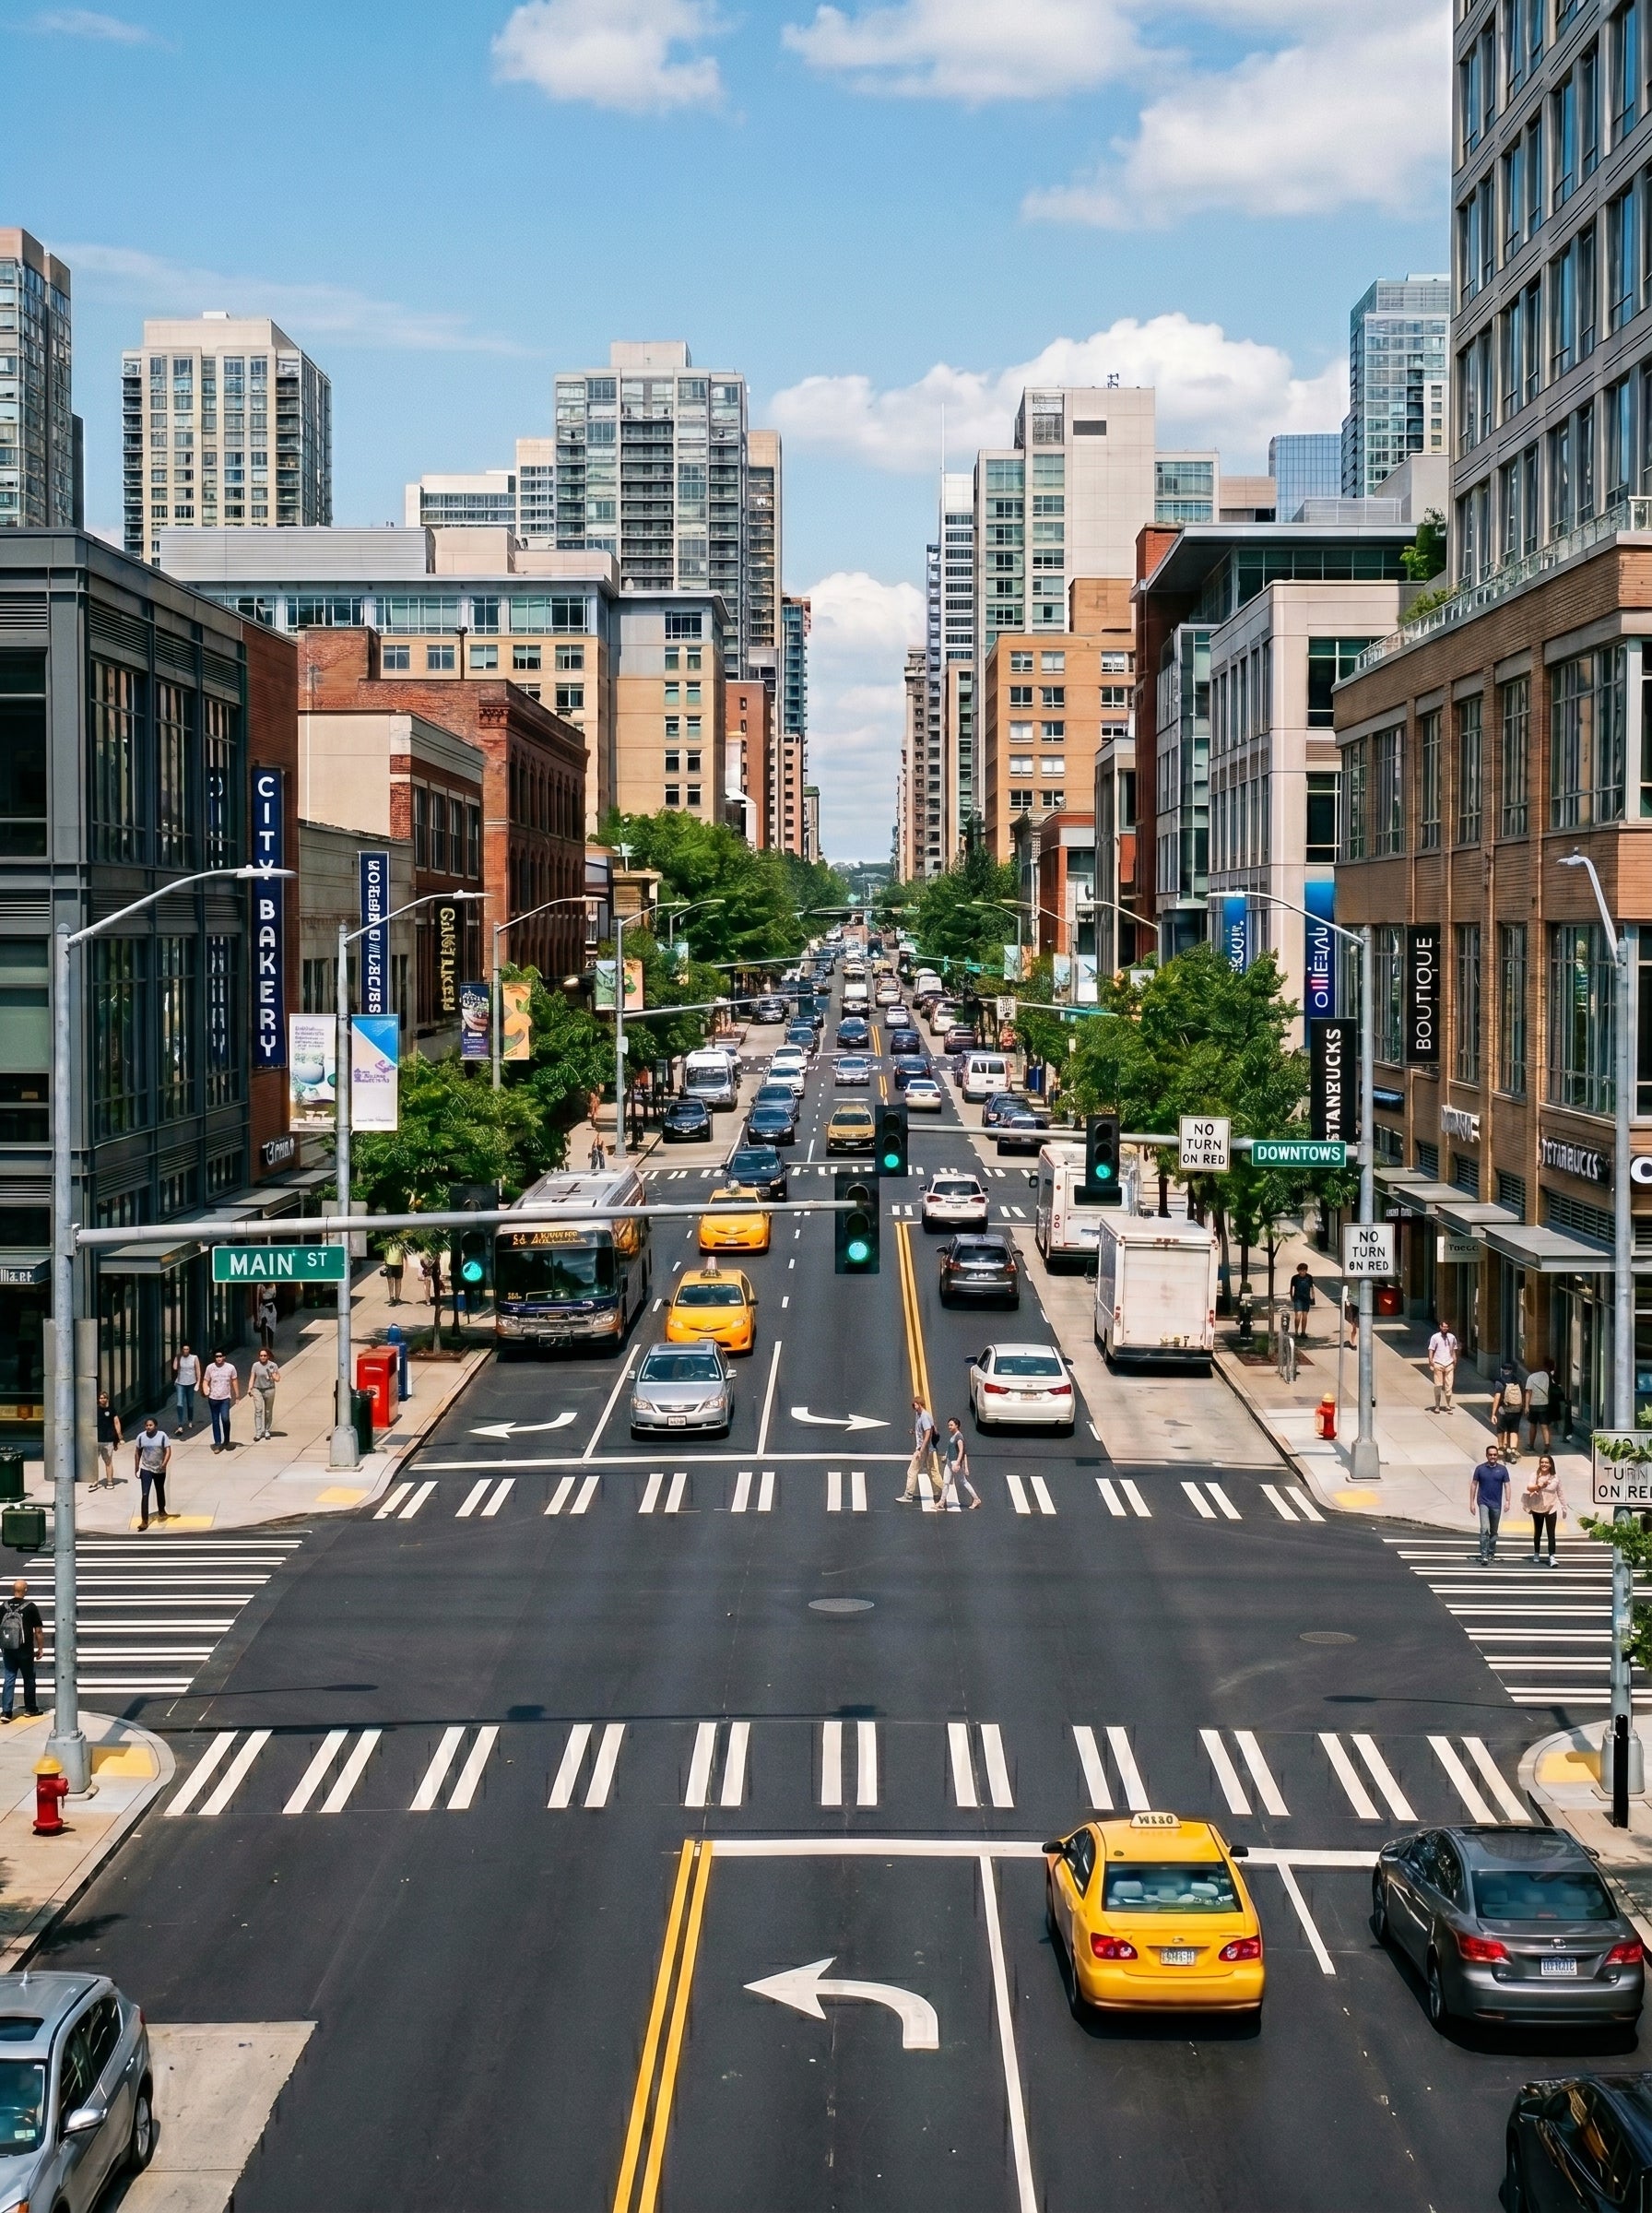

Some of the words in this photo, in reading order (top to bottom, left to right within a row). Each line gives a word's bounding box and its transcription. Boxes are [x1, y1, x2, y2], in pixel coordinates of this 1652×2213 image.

[257, 776, 276, 880] CITY
[259, 899, 277, 1058] BAKERY
[1416, 937, 1433, 1050] BOUTIQUE
[1194, 1123, 1214, 1136] NO
[1186, 1139, 1222, 1151] TURN
[1182, 1154, 1198, 1164] ON
[1203, 1154, 1225, 1165] RED
[1257, 1146, 1341, 1161] DOWNTOWS
[1359, 1231, 1379, 1243] NO
[1351, 1247, 1386, 1258] TURN
[230, 1253, 293, 1276] MAIN
[307, 1252, 328, 1267] ST
[1368, 1261, 1389, 1271] RED
[1598, 1485, 1621, 1498] ON
